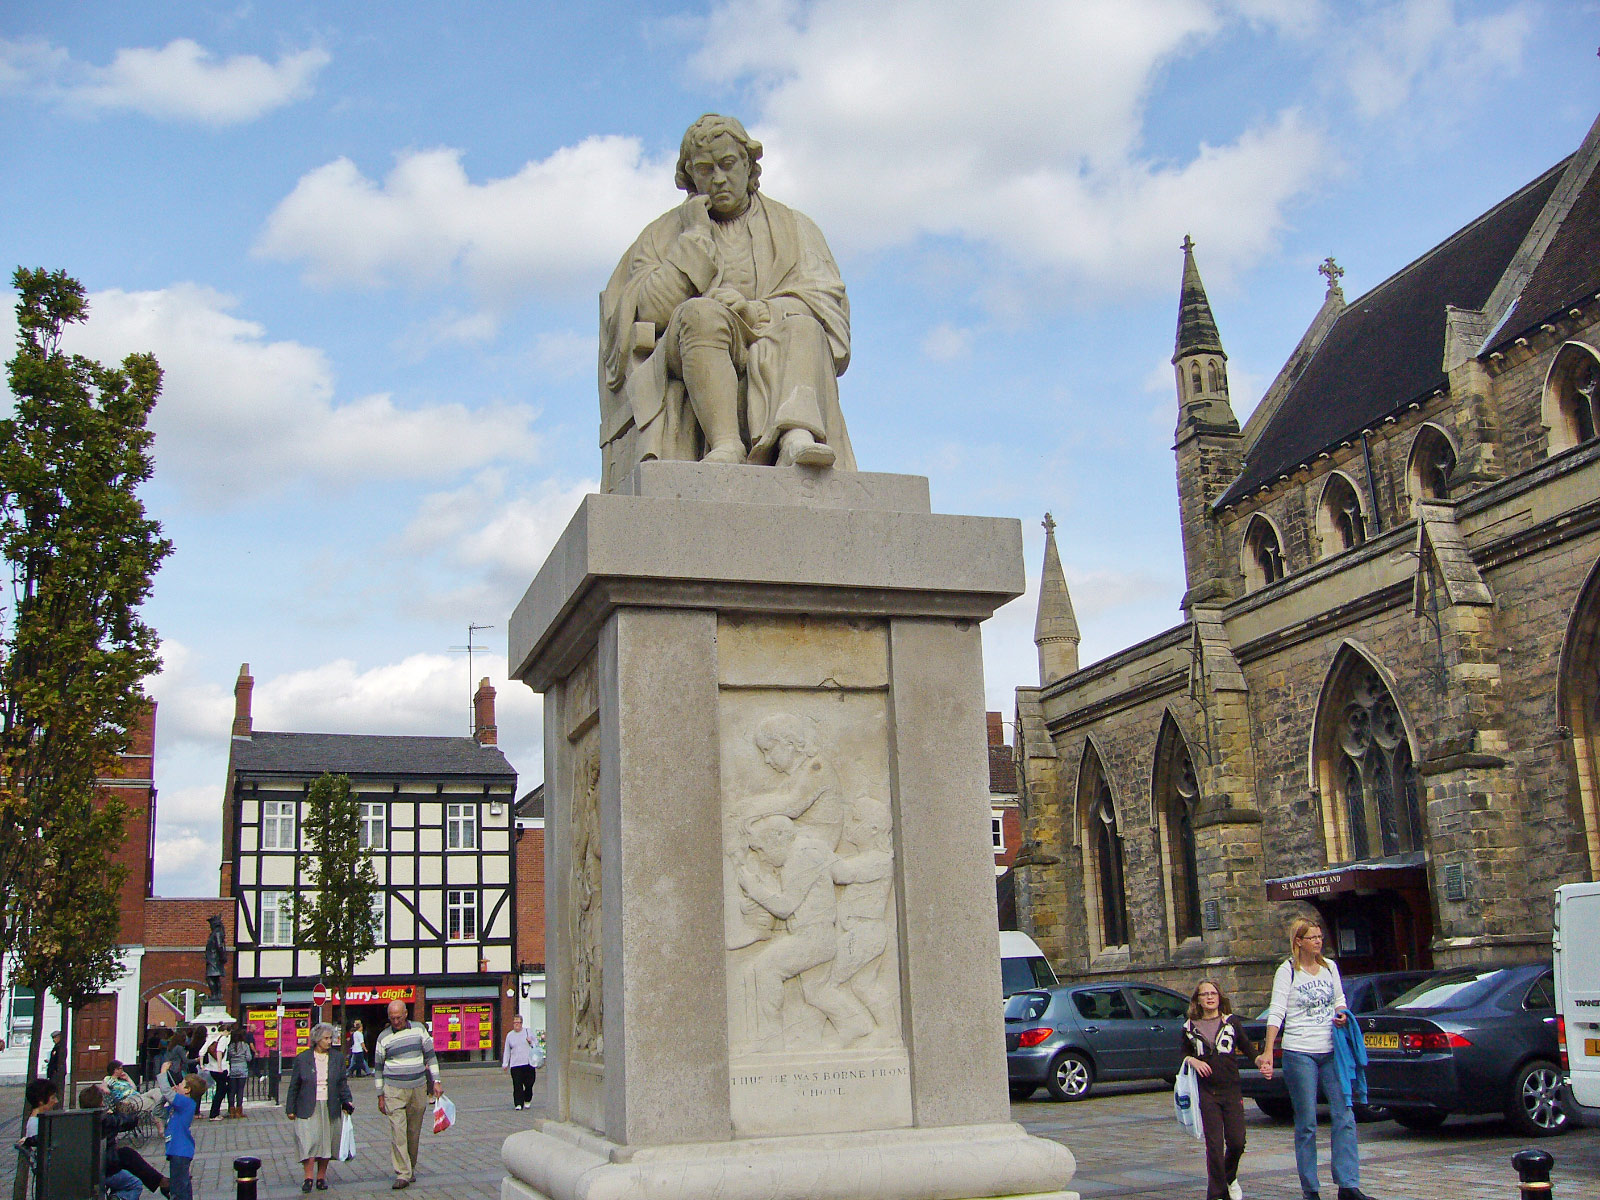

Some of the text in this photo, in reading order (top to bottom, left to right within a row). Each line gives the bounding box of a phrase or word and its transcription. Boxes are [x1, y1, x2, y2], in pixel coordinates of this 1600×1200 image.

[1290, 881, 1307, 890] MARY'S
[1308, 877, 1328, 887] CENTRE
[1329, 875, 1341, 883] AND
[1292, 885, 1331, 897] GUILD CHURCH
[770, 1074, 787, 1084] HE
[794, 1072, 819, 1081] WAS
[823, 1069, 866, 1081] BORNE
[872, 1066, 908, 1078] FROM
[794, 1086, 846, 1097] SCHOOL
